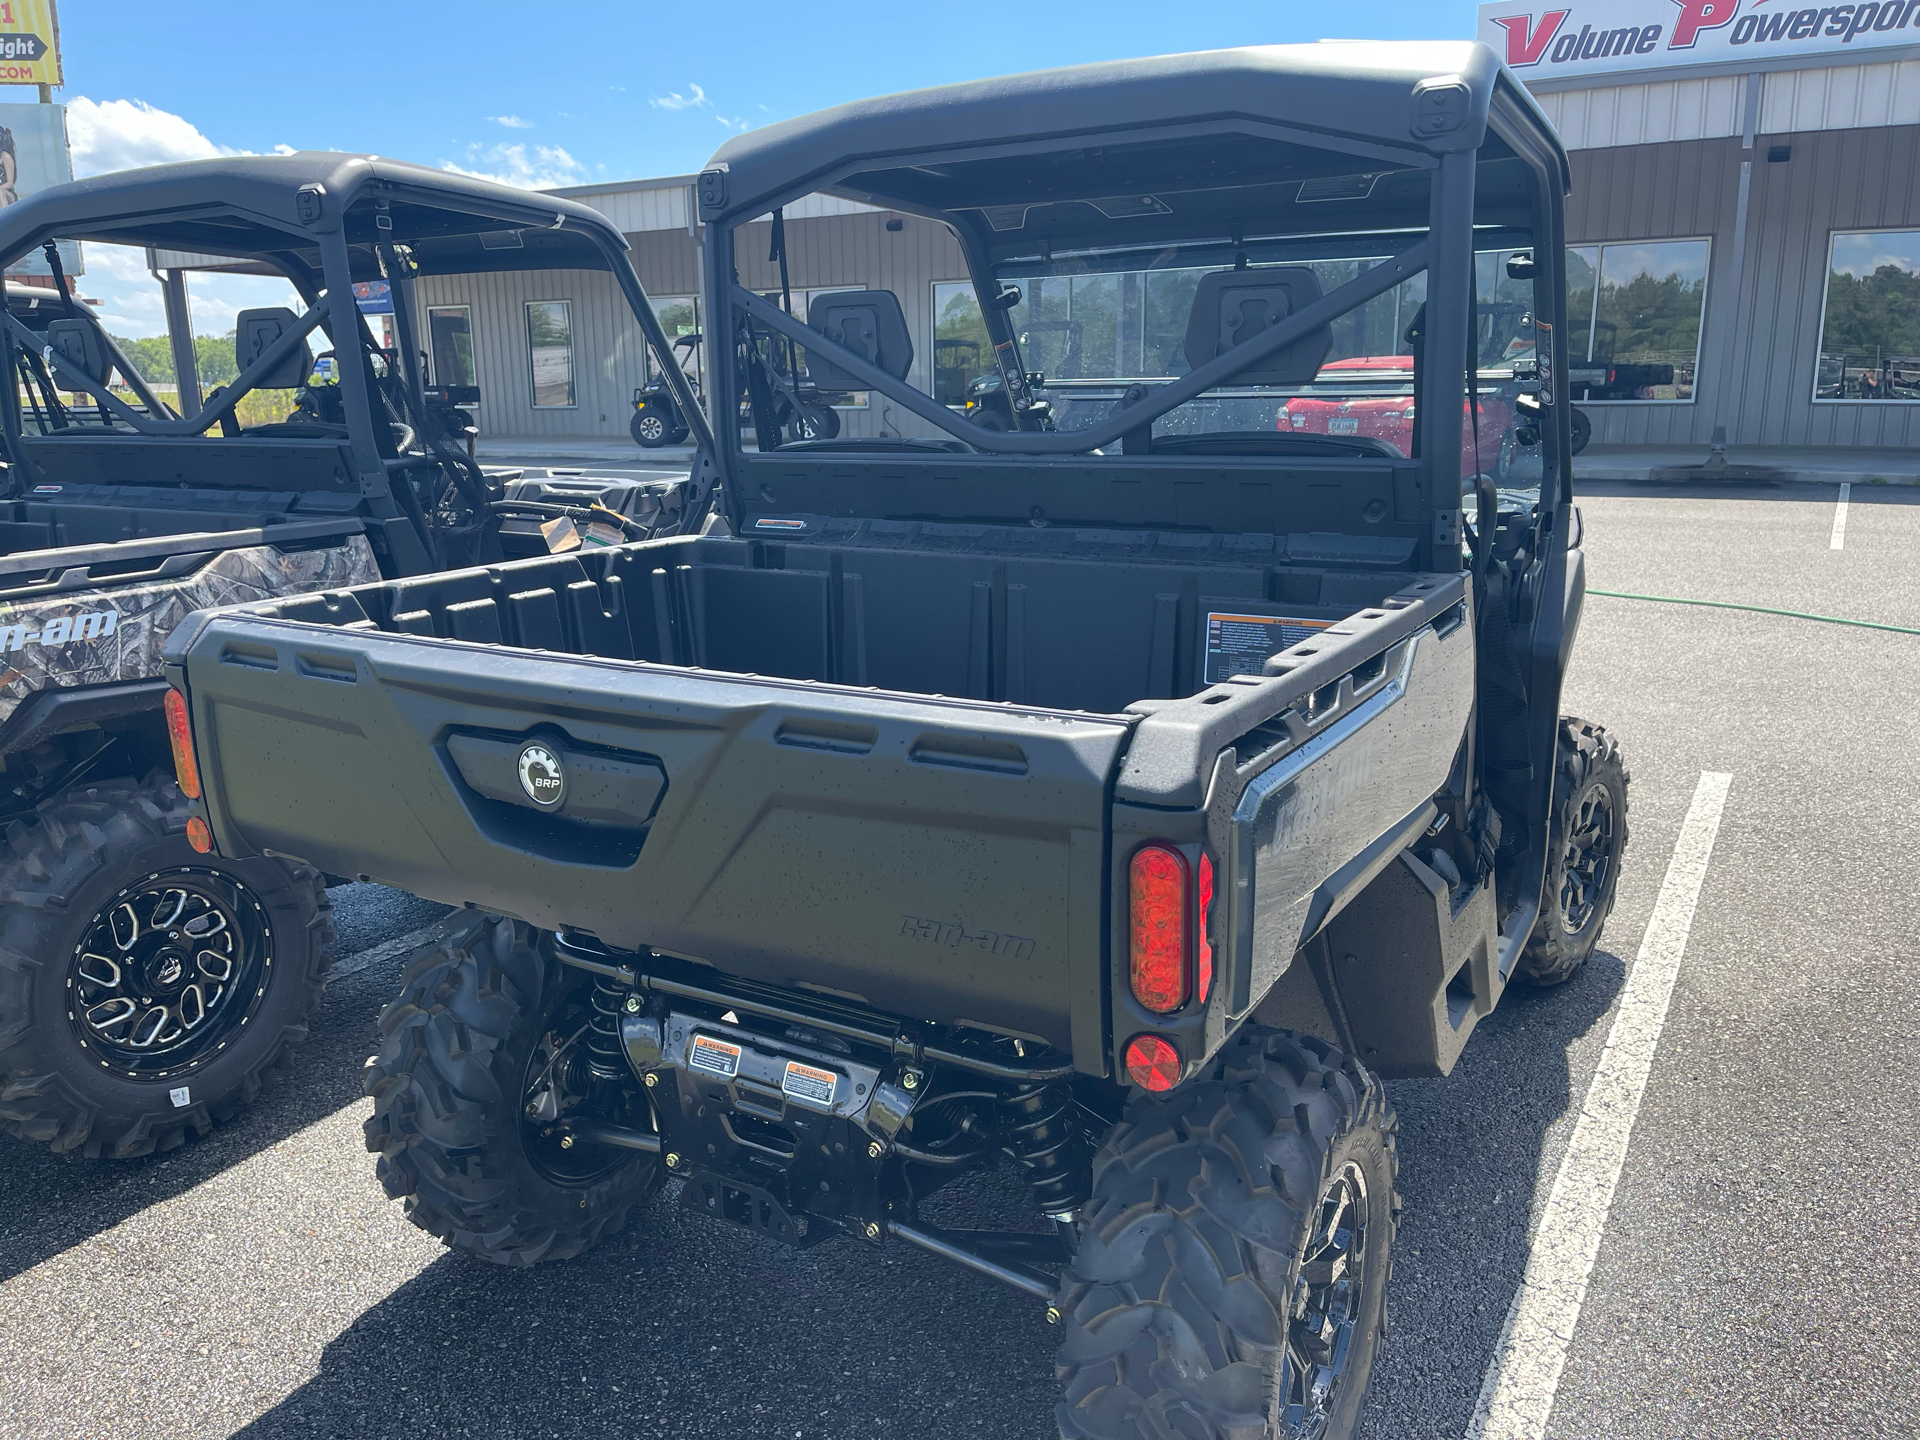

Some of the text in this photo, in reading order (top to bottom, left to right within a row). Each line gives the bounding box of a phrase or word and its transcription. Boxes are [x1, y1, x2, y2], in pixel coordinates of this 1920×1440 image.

[0, 2, 15, 24] 1
[0, 37, 35, 59] ight
[1489, 9, 1663, 68] Volume
[0, 609, 119, 653] n-am
[535, 777, 560, 789] BRP
[900, 914, 1036, 961] can-am
[708, 1043, 733, 1054] WARNING
[801, 1067, 828, 1080] WARNING
